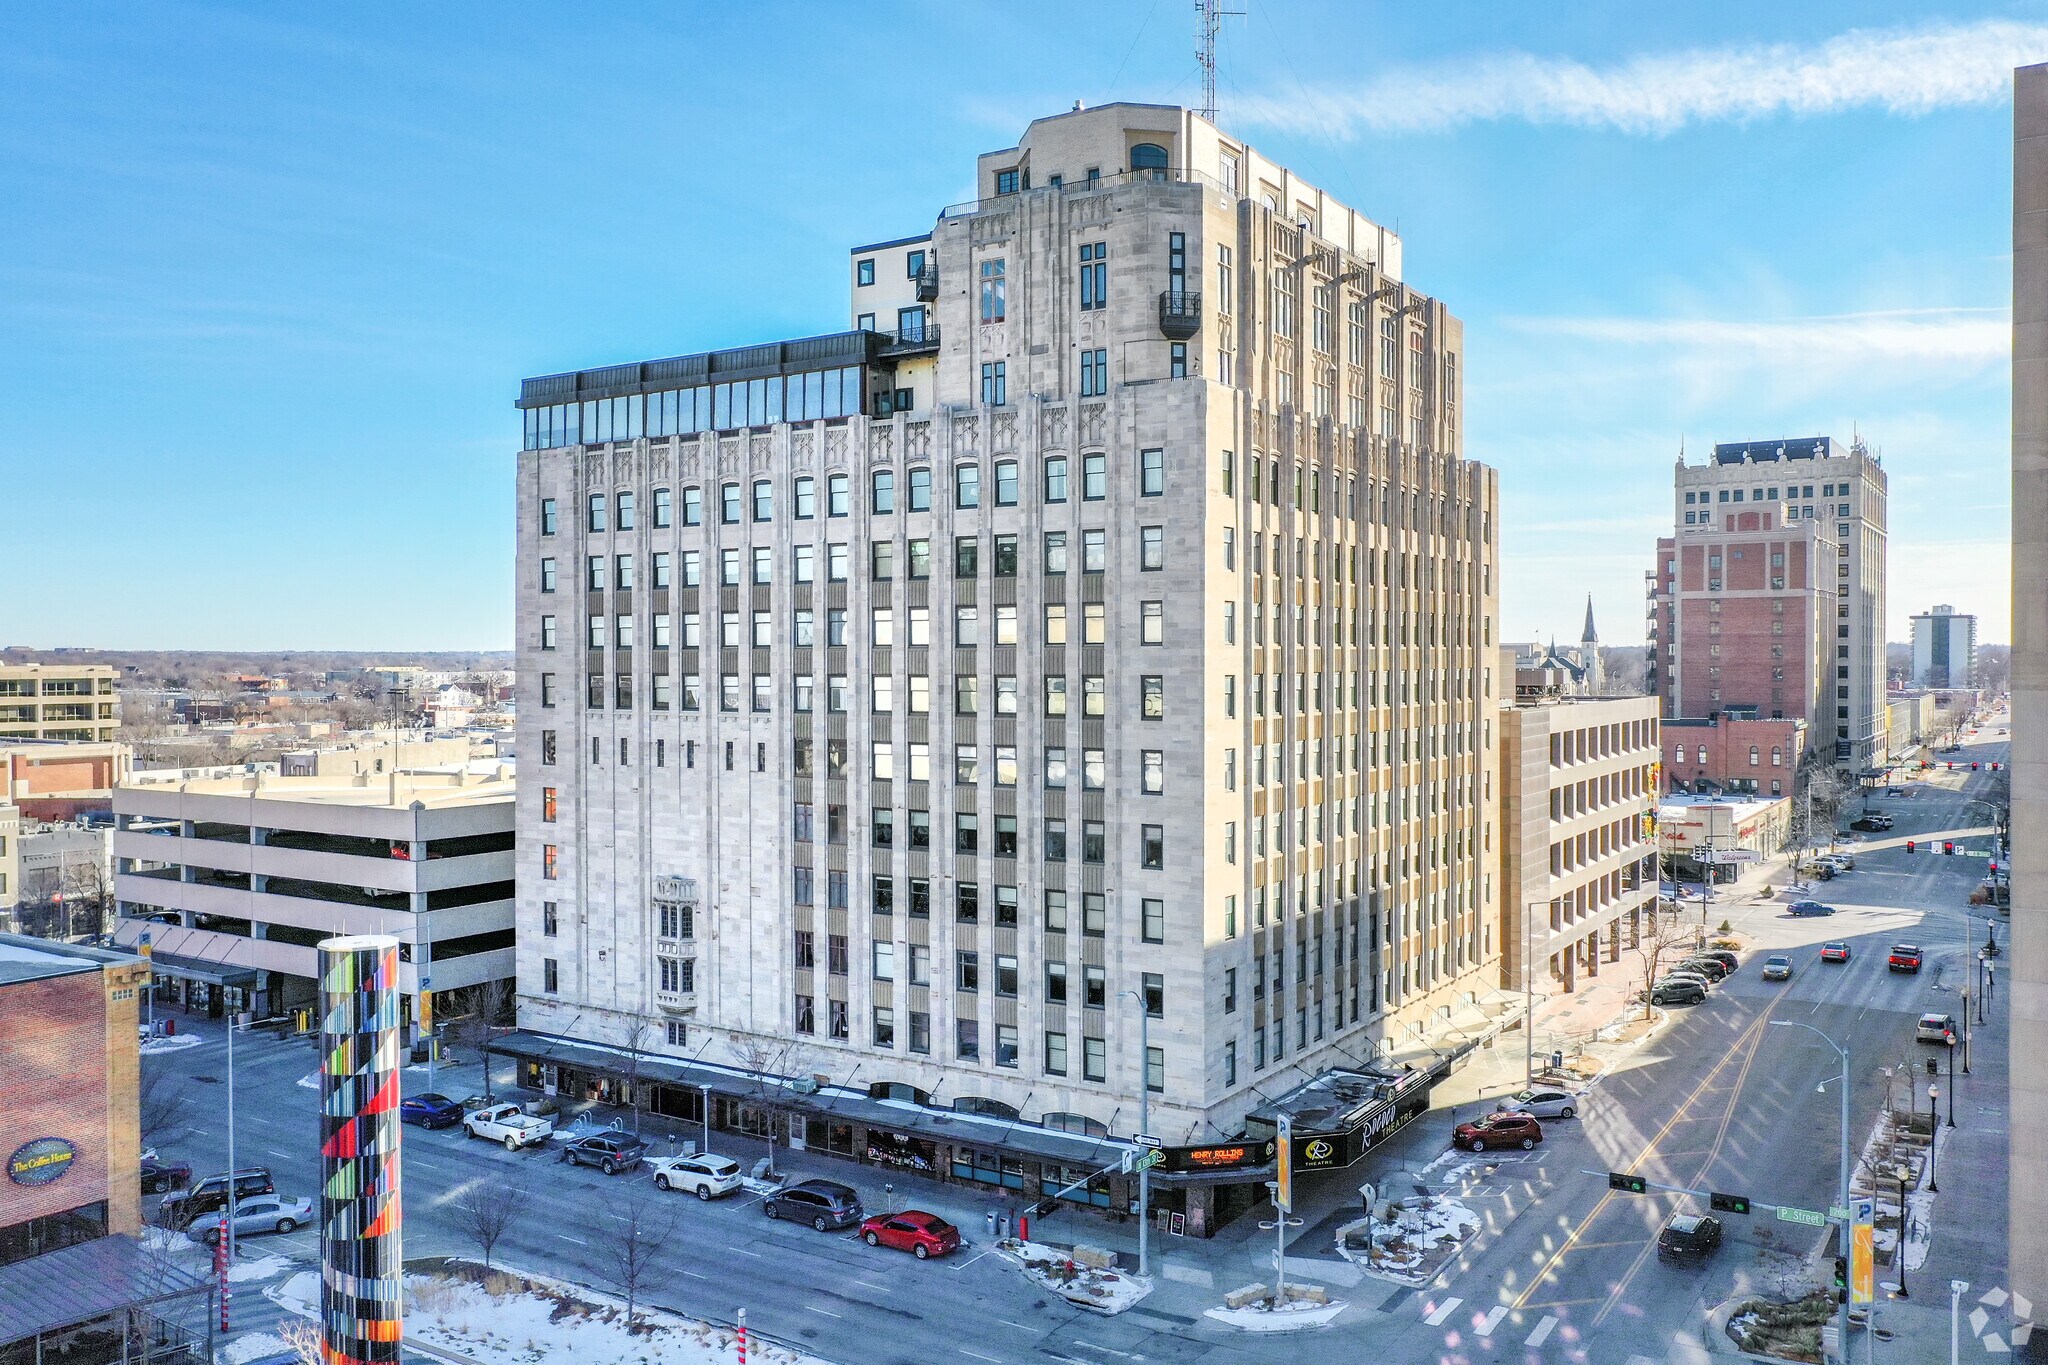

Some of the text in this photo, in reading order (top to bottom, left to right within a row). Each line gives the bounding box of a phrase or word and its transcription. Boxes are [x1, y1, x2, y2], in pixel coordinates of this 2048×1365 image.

[1382, 1110, 1413, 1137] THEATRE
[1191, 1151, 1212, 1159] HENRY
[1215, 1149, 1244, 1157] ROLLINS
[14, 1153, 72, 1172] The Coffee House
[1781, 1209, 1820, 1224] P Street
[1859, 1204, 1871, 1218] P
